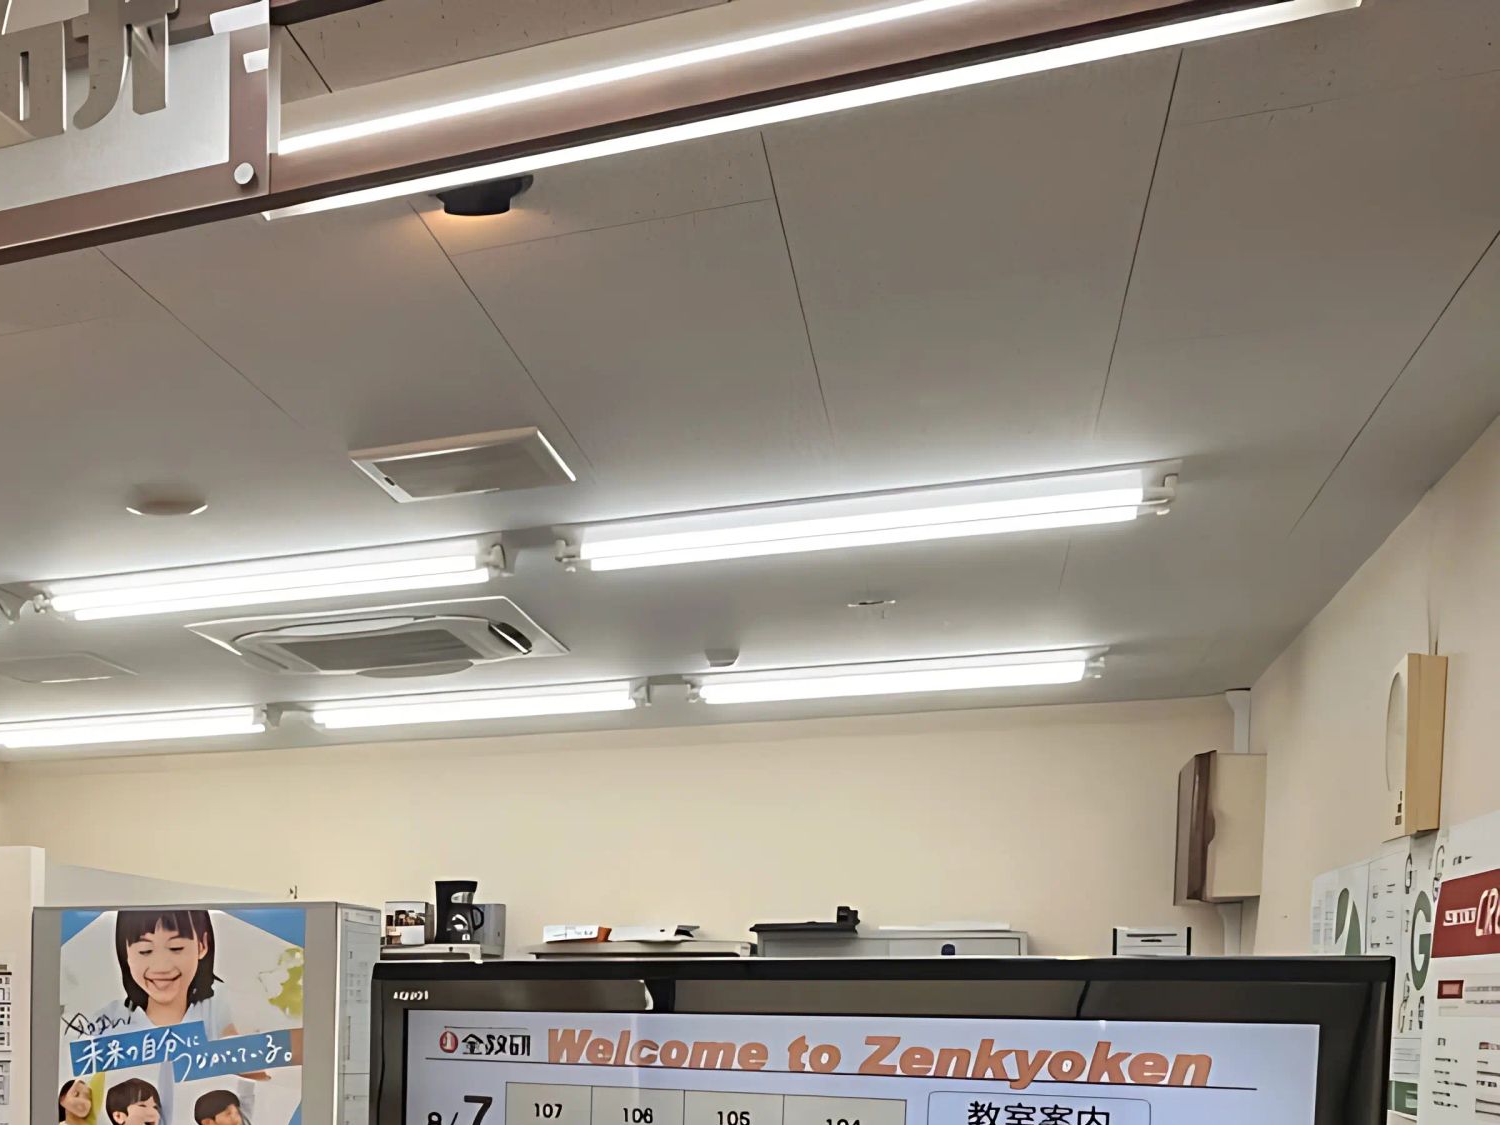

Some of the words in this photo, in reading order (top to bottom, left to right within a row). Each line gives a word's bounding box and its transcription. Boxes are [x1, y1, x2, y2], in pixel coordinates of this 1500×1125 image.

[547, 1028, 770, 1068] Welcome
[787, 1034, 842, 1071] to
[857, 1035, 1213, 1090] Zenkyoken
[533, 1102, 563, 1119] 107
